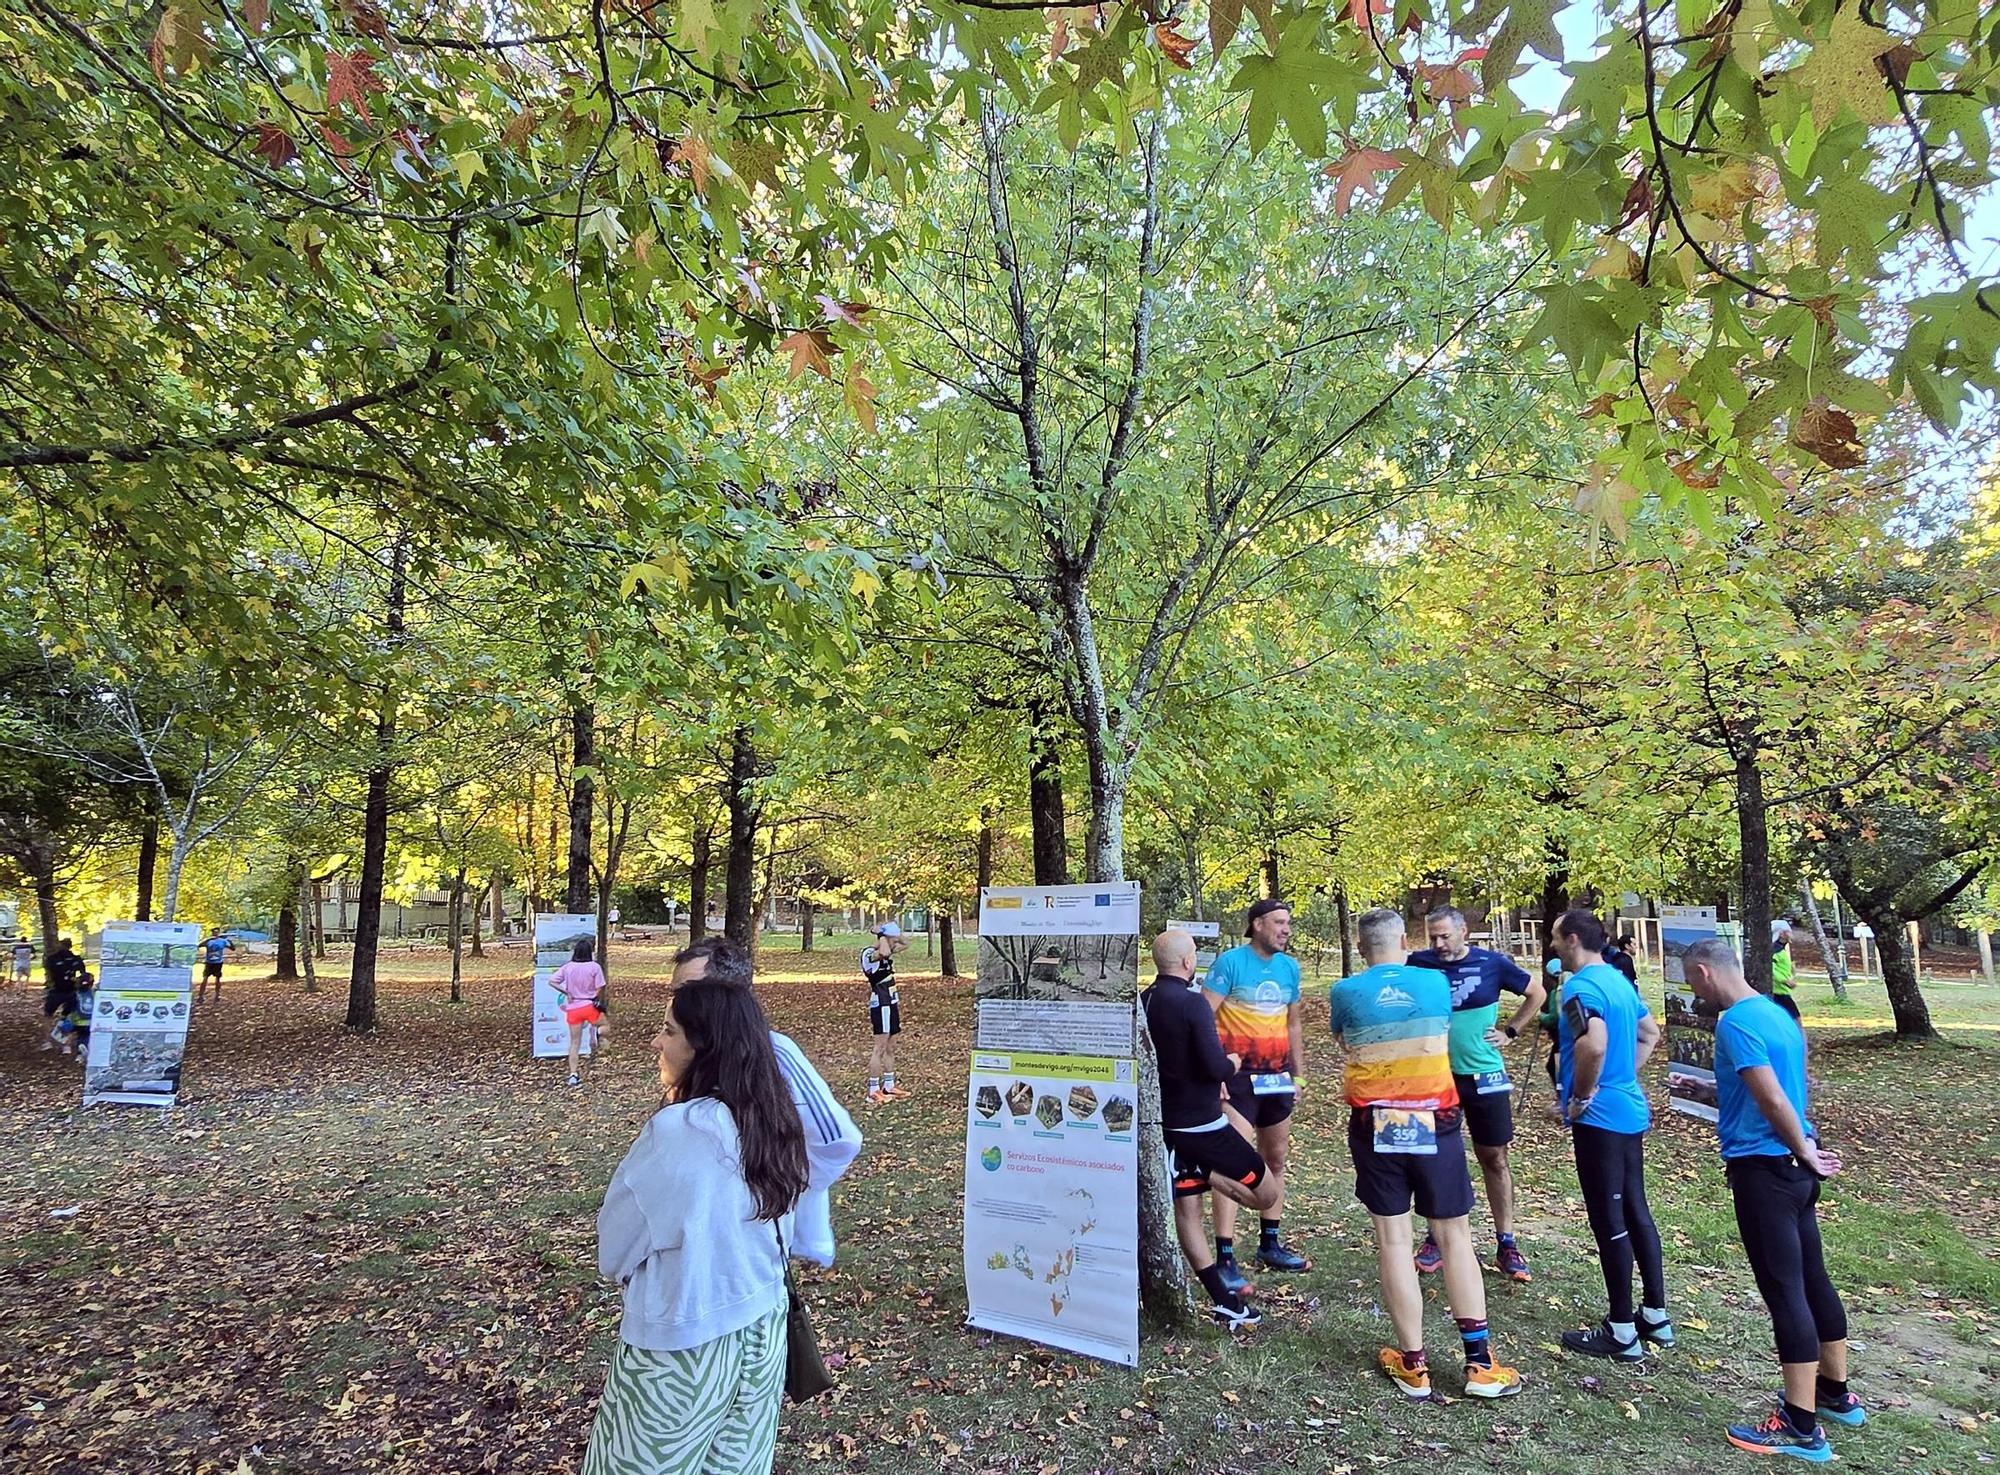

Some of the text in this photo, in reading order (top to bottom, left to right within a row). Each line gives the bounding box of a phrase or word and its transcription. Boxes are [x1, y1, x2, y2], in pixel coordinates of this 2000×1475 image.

[1392, 1128, 1419, 1141] 359
[1007, 1150, 1036, 1162] Servizos
[1088, 1160, 1125, 1171] asociados
[1016, 1165, 1046, 1174] carbono
